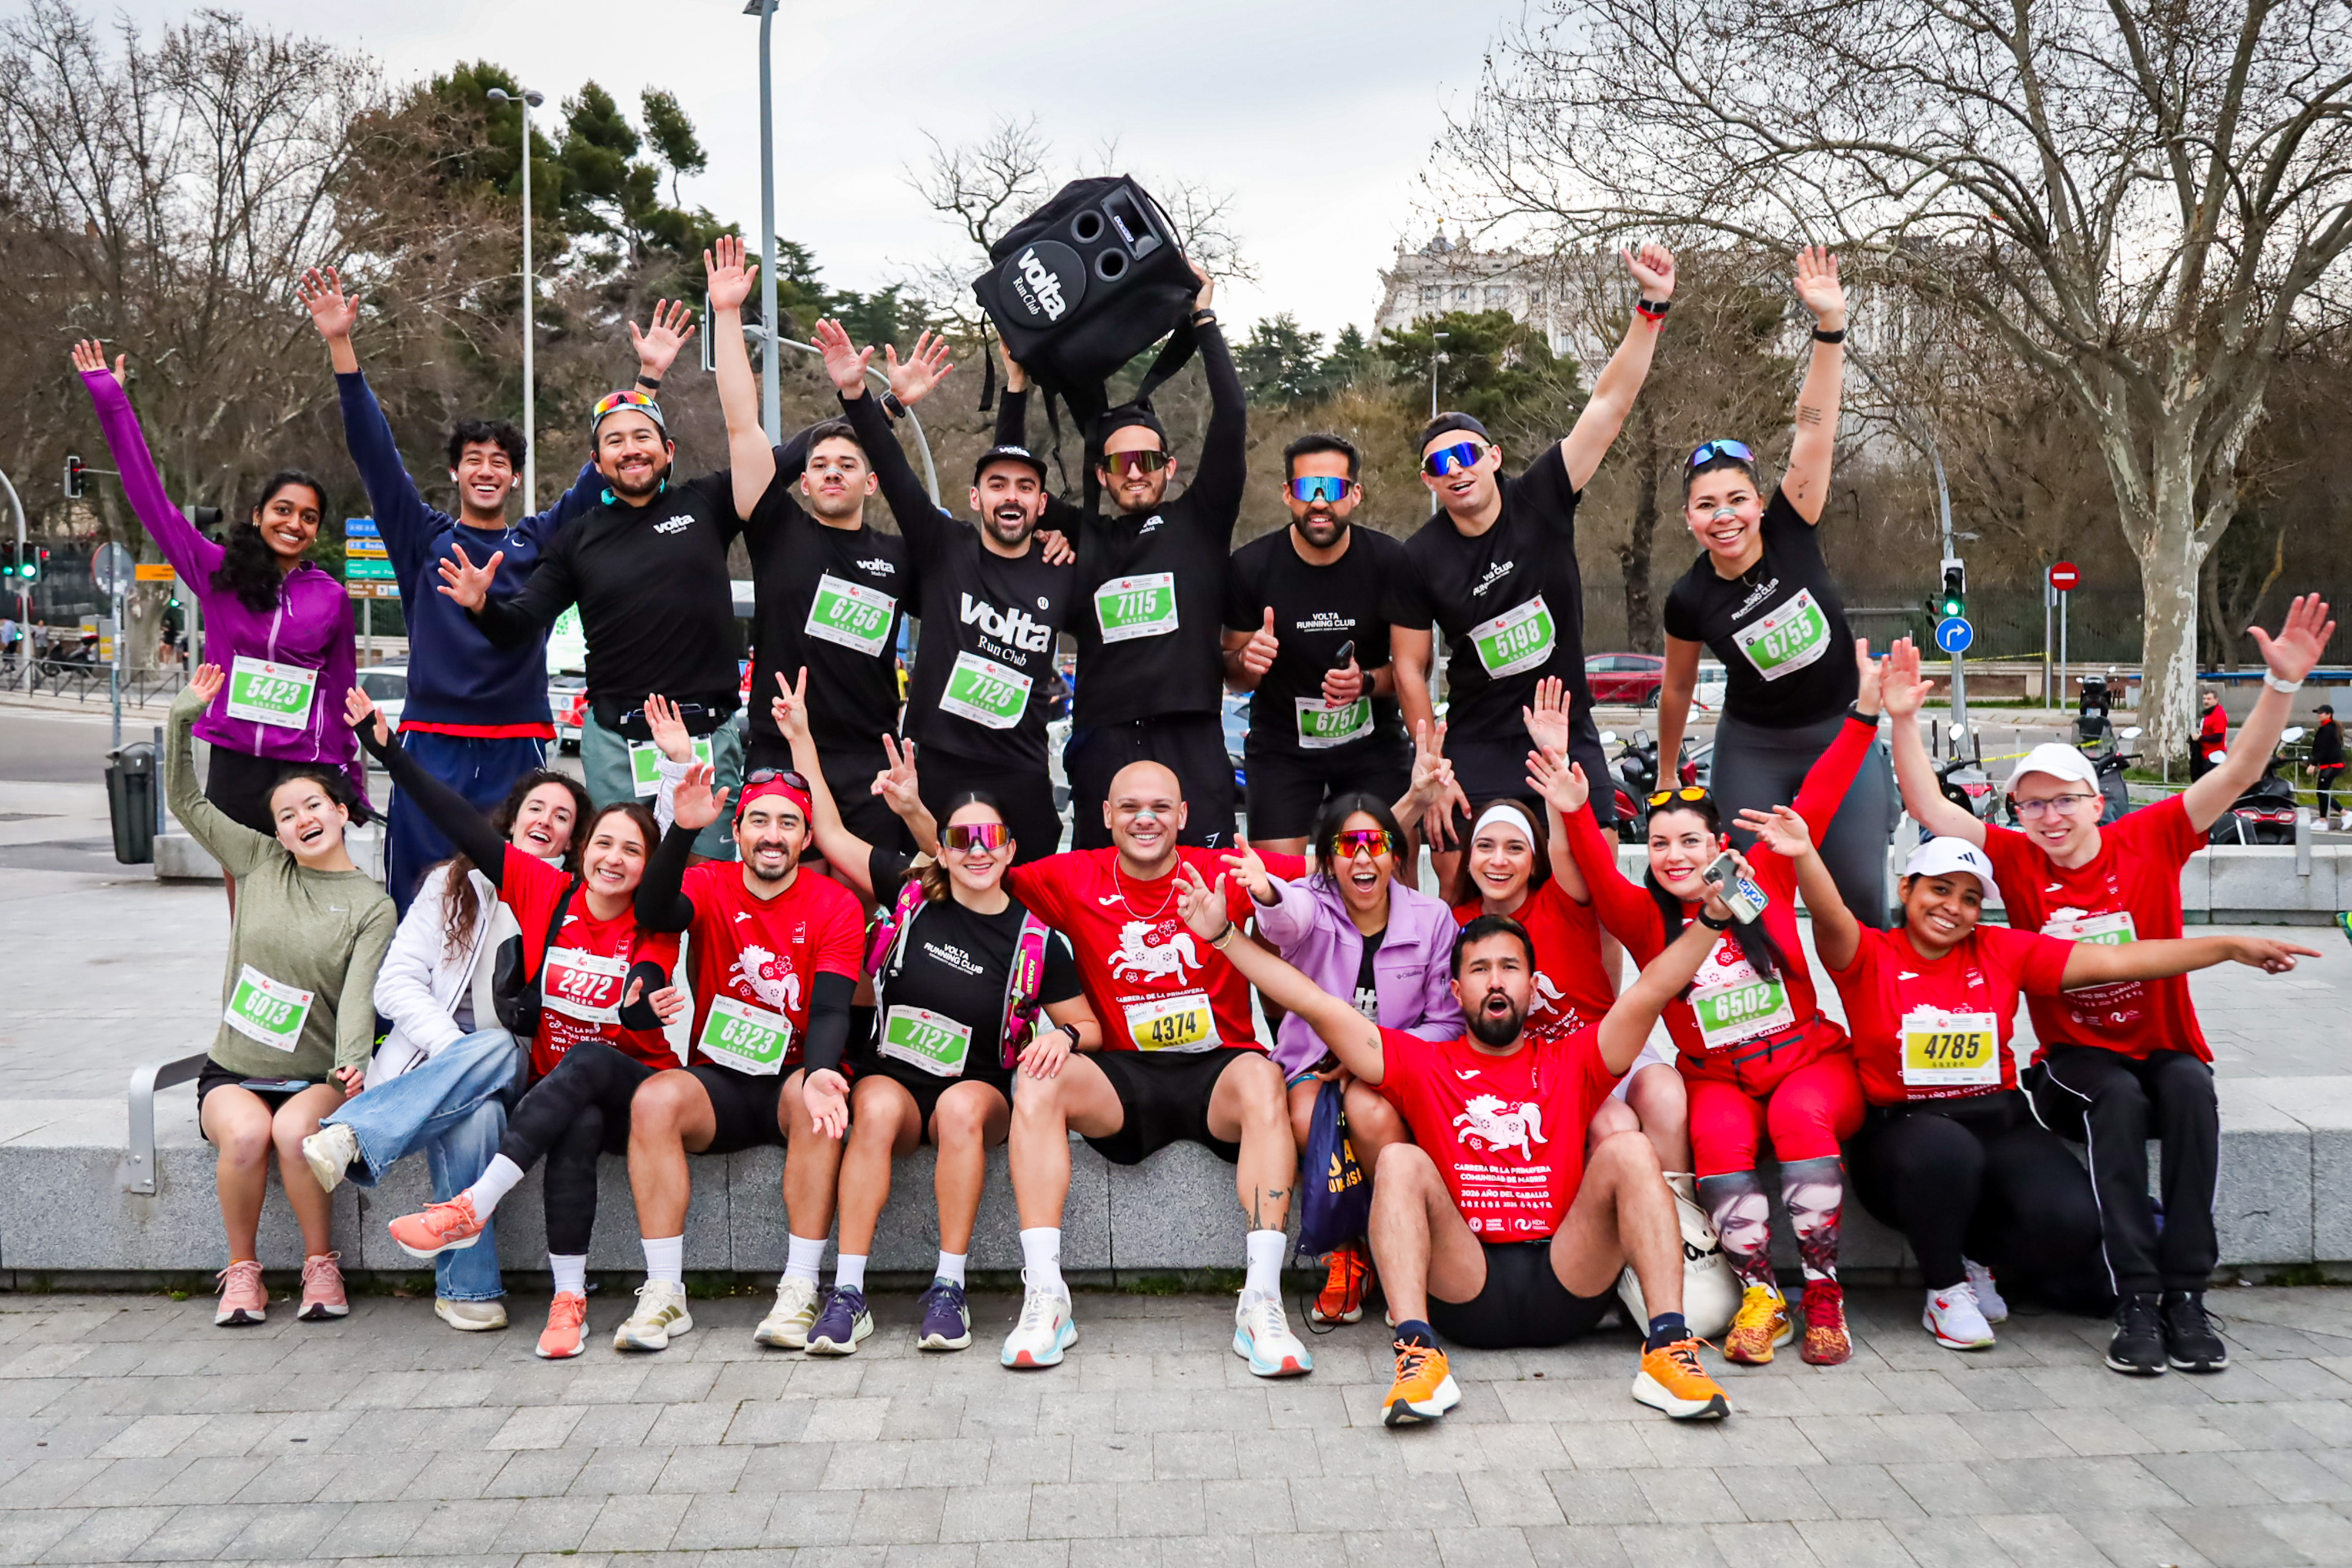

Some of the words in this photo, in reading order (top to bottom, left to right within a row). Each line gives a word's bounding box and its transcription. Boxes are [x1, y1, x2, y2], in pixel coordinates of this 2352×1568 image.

[1013, 275, 1028, 298] Run
[1023, 294, 1041, 315] Club
[1018, 247, 1067, 322] volta
[653, 514, 695, 534] volta
[856, 559, 896, 574] volta
[1494, 560, 1514, 575] CLUB
[829, 597, 882, 631] 6756
[1117, 590, 1157, 618] 7115
[1312, 612, 1339, 620] VOLTA
[960, 591, 1052, 653] volta
[1297, 620, 1333, 629] RUNNING
[1334, 618, 1356, 627] CLUB
[1765, 612, 1813, 658] 6755
[977, 635, 1001, 657] Run
[1002, 648, 1027, 667] Club
[1495, 618, 1541, 658] 5198
[246, 676, 302, 706] 5423
[966, 674, 1015, 707] 7126
[1316, 703, 1359, 731] 6757
[1738, 879, 1763, 907] volta
[924, 942, 961, 965] RUNNING
[961, 959, 984, 974] CLUB
[944, 943, 970, 960] VOLTA
[558, 969, 613, 999] 2272
[1115, 995, 1145, 1003] CARRERA
[1166, 987, 1205, 998] PRIMAVERA
[245, 990, 293, 1025] 6013
[1715, 984, 1772, 1021] 6502
[720, 1018, 777, 1054] 6323
[906, 1022, 955, 1053] 7127
[1152, 1011, 1197, 1043] 4374
[1924, 1034, 1981, 1059] 4785
[1928, 1091, 1946, 1099] AÑO
[1454, 1163, 1489, 1172] CARRERA
[1511, 1166, 1552, 1174] PRIMAVERA
[1460, 1174, 1506, 1182] COMUNIDAD
[1481, 1189, 1499, 1198] AÑO
